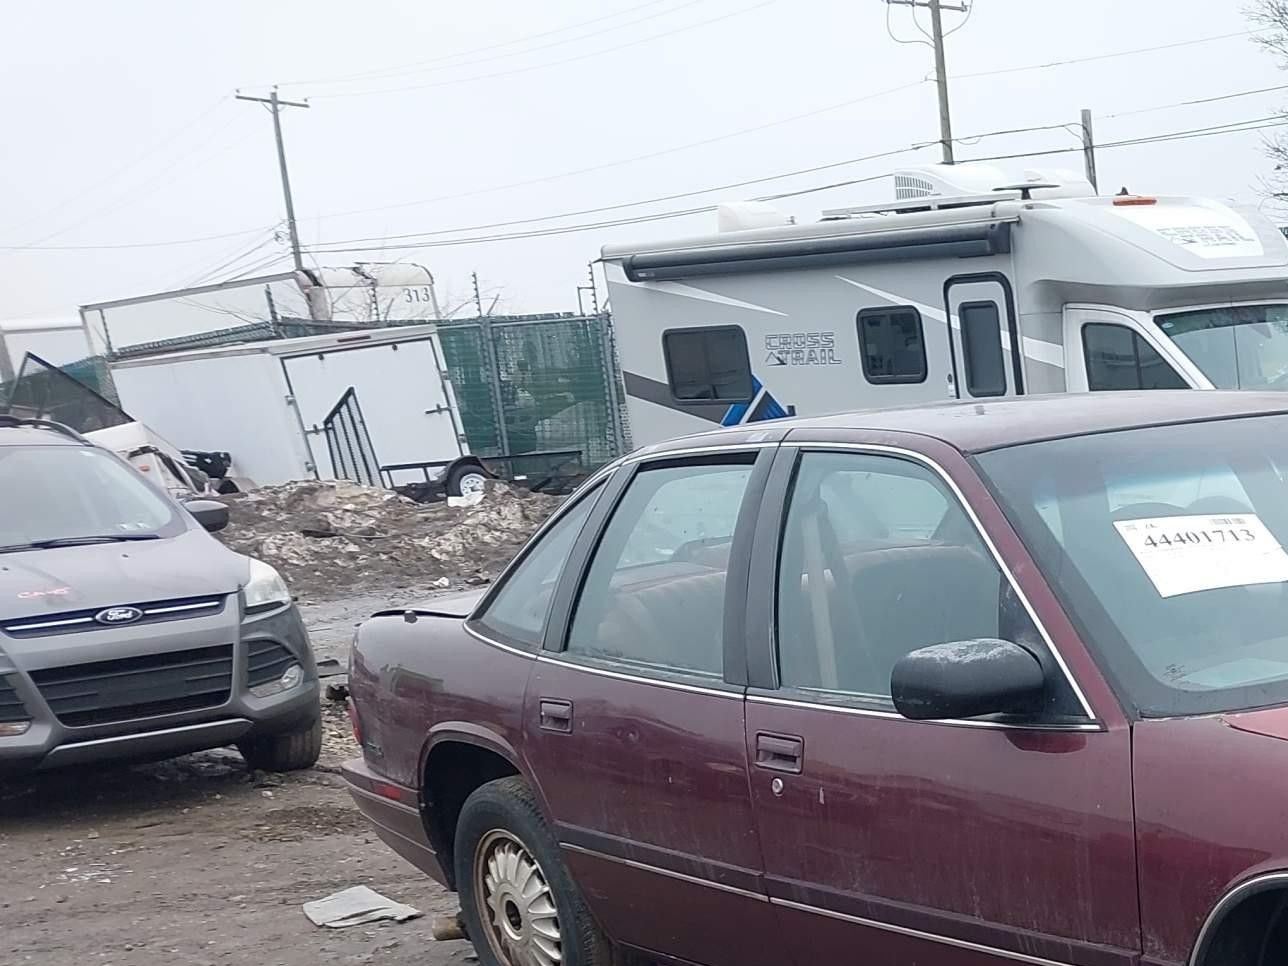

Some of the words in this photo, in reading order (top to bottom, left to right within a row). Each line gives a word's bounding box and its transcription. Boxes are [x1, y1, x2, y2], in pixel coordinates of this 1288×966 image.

[765, 332, 835, 350] CROSS
[777, 348, 842, 366] TRAIL
[1144, 529, 1256, 547] 44401713
[107, 609, 133, 621] Ford
